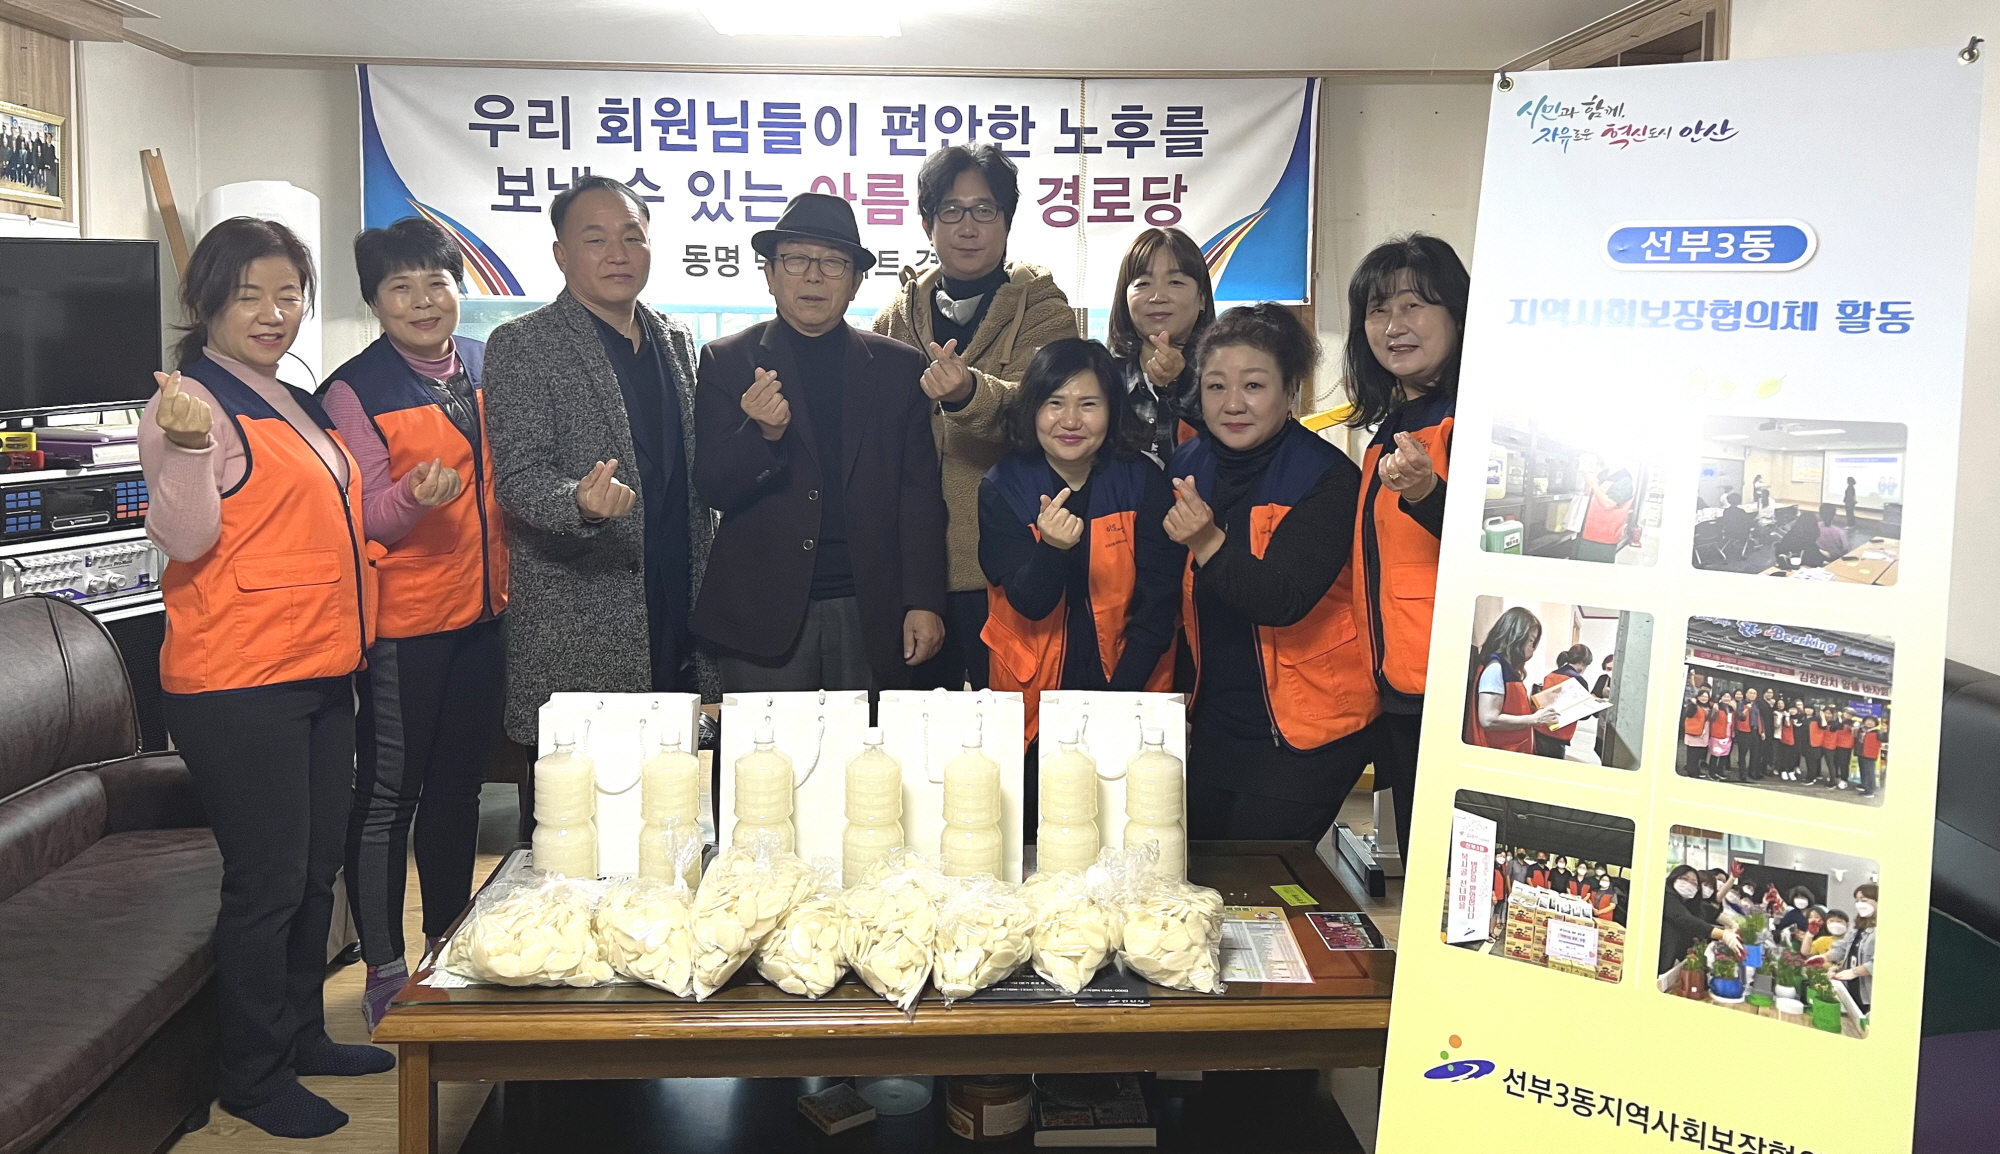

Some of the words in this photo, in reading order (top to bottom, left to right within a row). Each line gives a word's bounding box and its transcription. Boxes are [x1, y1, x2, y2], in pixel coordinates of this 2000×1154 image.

[468, 94, 570, 150] 우리
[596, 96, 858, 157] 회원님들이
[881, 103, 1036, 158] 편안한
[1053, 105, 1210, 160] 노후를
[1516, 95, 1579, 129] 시민과
[1532, 126, 1594, 153] 자유로운
[1600, 123, 1673, 150] 혁신도시
[1679, 118, 1740, 143] 안산
[687, 169, 788, 223] 있는
[1036, 173, 1189, 228] 경로당
[682, 243, 741, 278] 동명
[1639, 230, 1776, 262] 선부3동
[1505, 297, 1819, 332] 지역사회보장협의체
[1835, 300, 1916, 335] 활동
